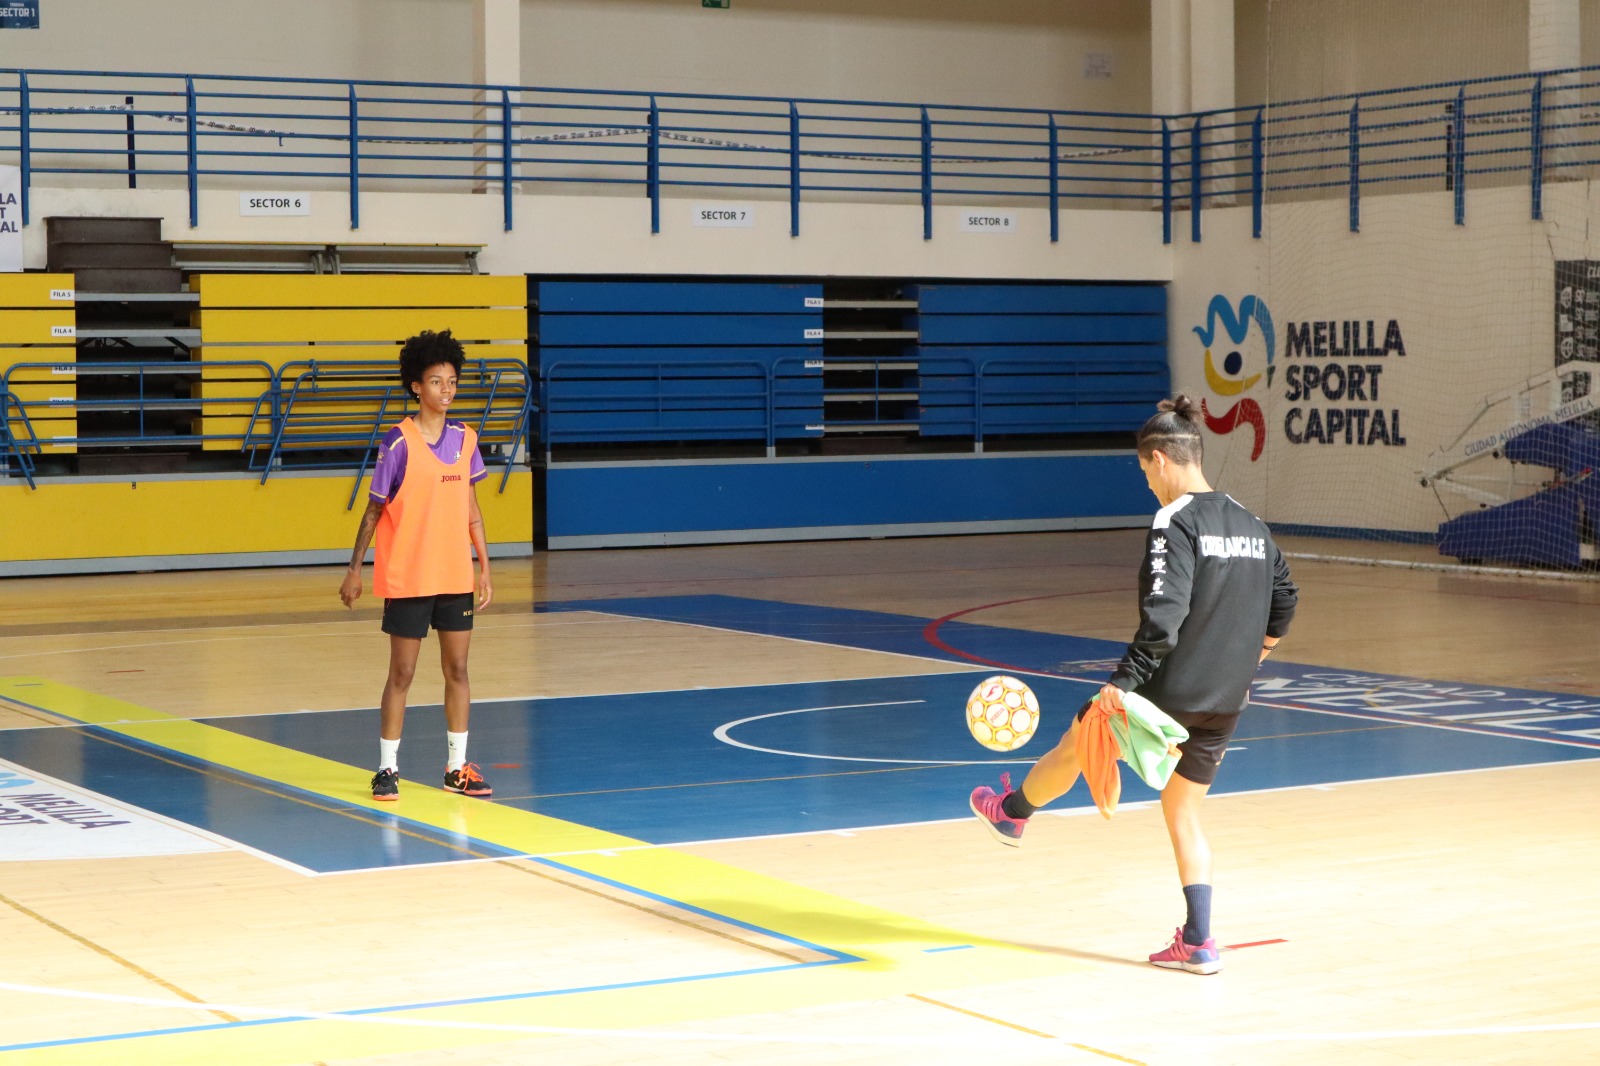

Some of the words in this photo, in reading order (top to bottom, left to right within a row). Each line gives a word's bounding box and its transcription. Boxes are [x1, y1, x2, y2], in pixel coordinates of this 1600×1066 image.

[31, 8, 35, 17] 1
[249, 198, 290, 208] SECTOR
[294, 198, 302, 208] 6
[701, 210, 737, 220] SECTOR
[740, 211, 746, 220] 7
[968, 216, 1001, 226] SECTOR
[1003, 217, 1010, 226] 8
[1285, 319, 1406, 358] MELILLA
[1284, 363, 1383, 402] SPORT
[1284, 407, 1406, 447] CAPITAL
[1464, 435, 1496, 457] CIUDAD
[1555, 398, 1594, 420] MELILLA
[1302, 673, 1506, 698] CIUDAD
[0, 793, 131, 829] MELILLA
